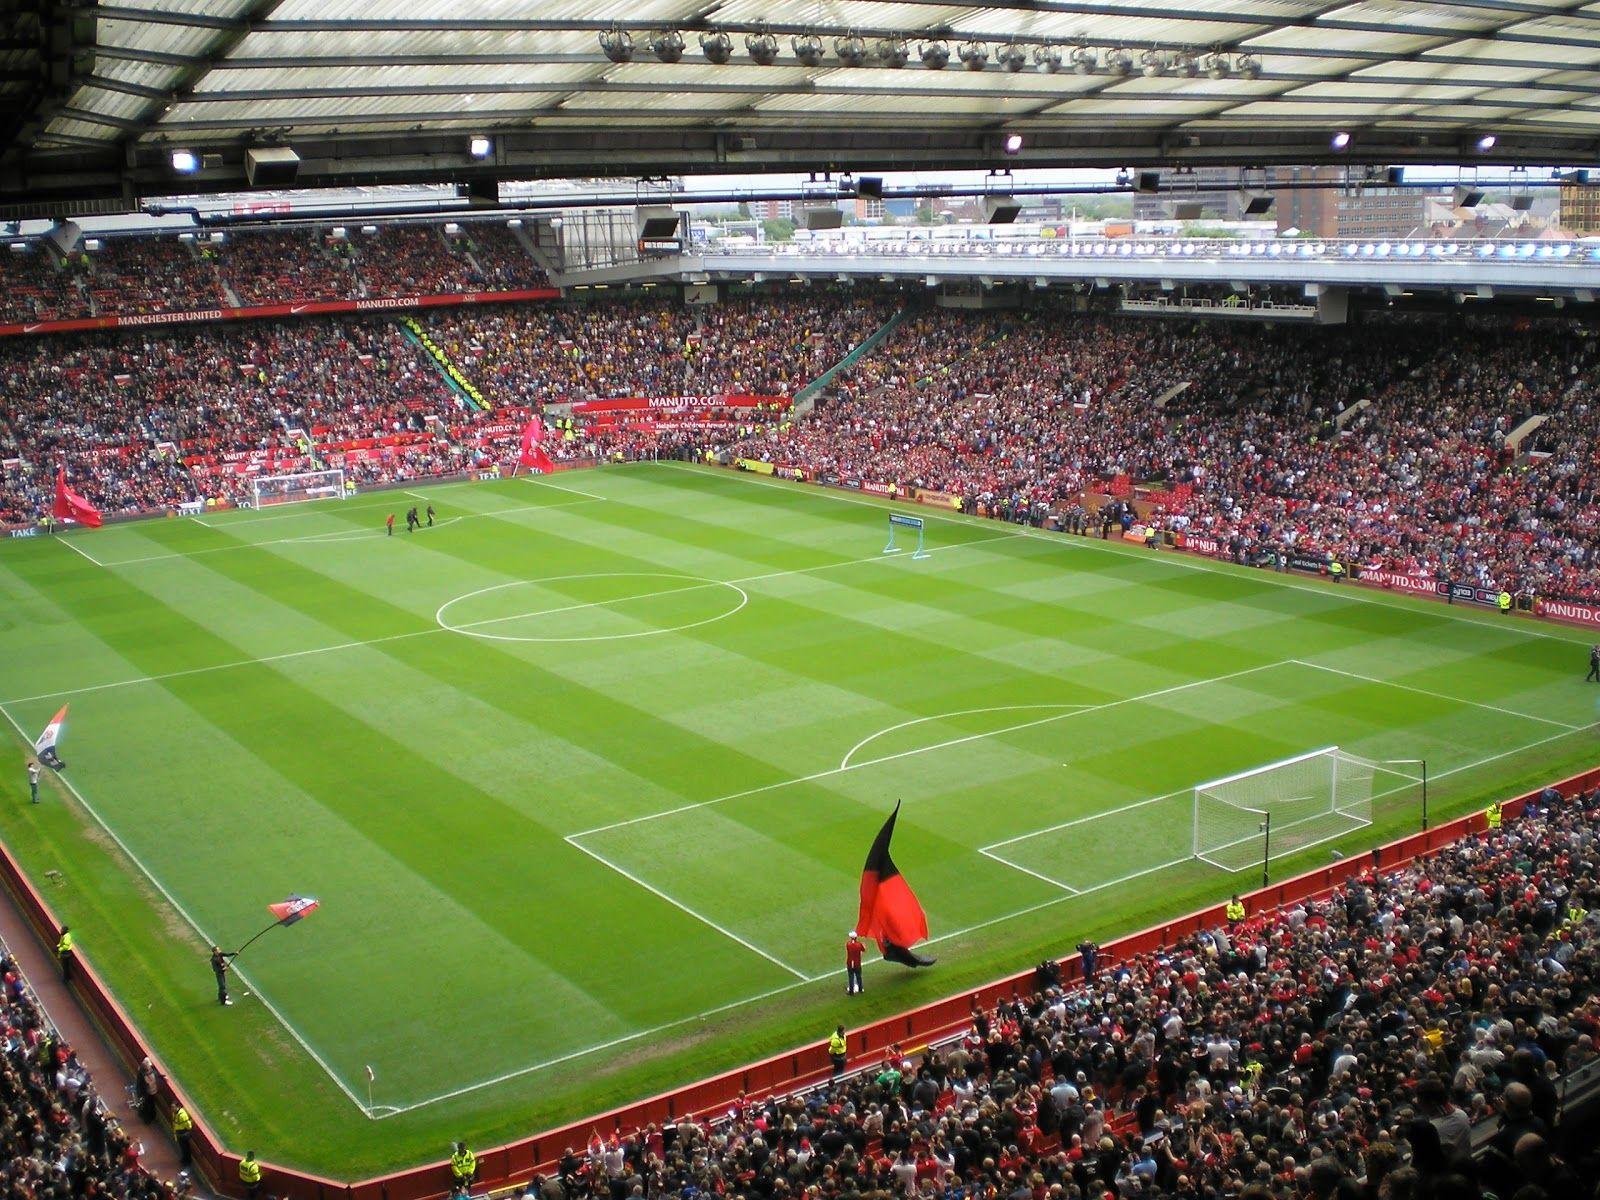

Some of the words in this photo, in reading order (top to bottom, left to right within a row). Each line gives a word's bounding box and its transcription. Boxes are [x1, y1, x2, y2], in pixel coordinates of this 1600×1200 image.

[356, 298, 419, 309] MANUTD.COM
[118, 314, 184, 326] MANCHESTER
[185, 310, 222, 321] UNITED
[10, 527, 36, 538] TAKE
